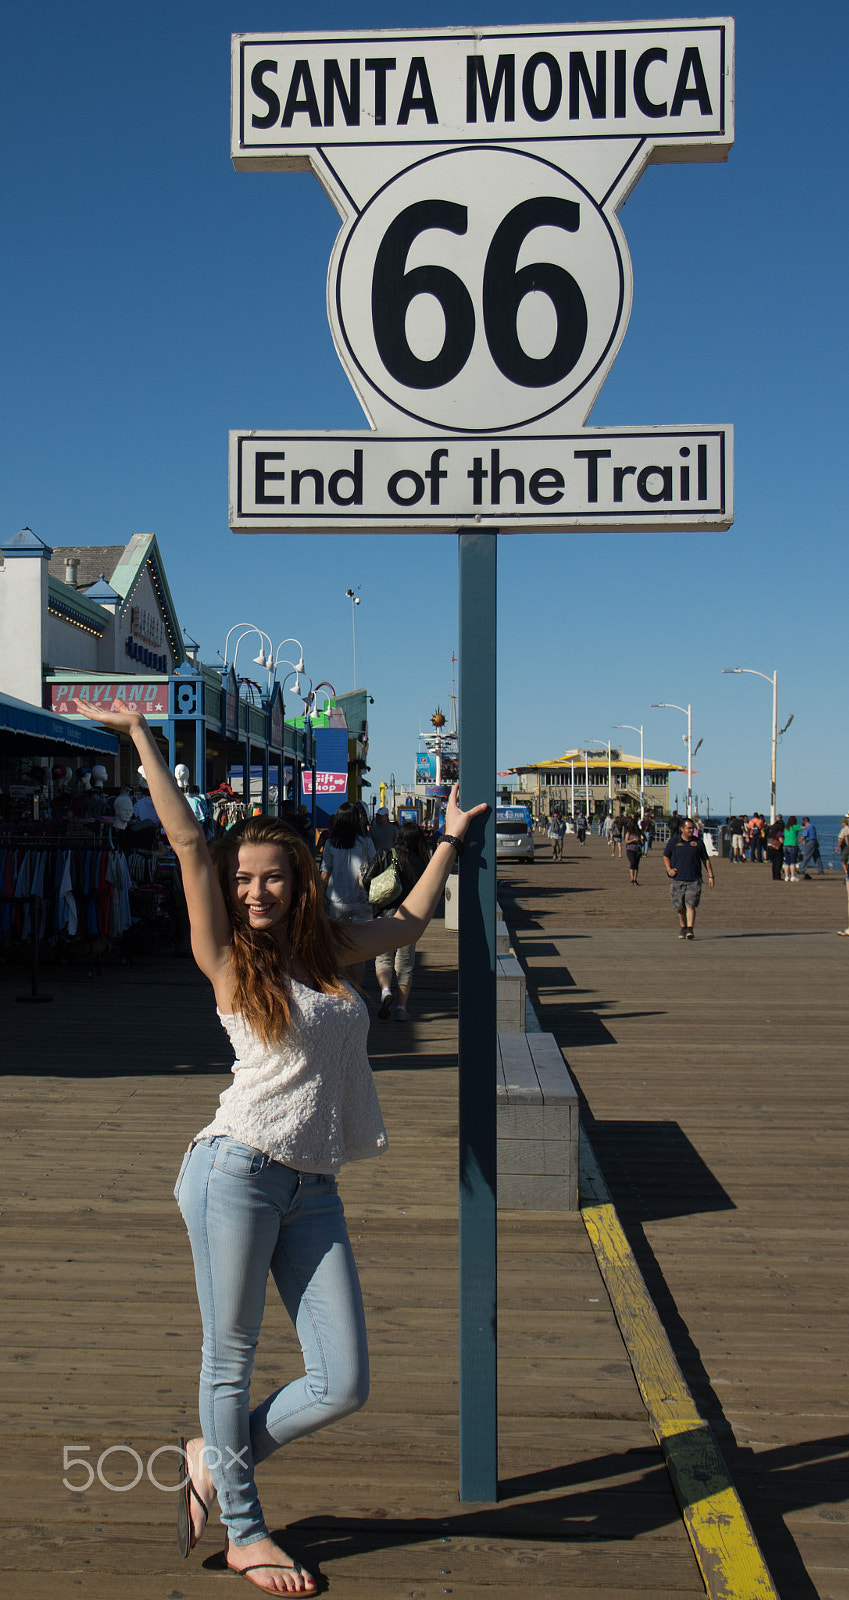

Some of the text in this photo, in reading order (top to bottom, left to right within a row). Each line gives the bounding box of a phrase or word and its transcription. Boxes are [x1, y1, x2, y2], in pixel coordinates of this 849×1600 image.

[250, 46, 713, 130] SANTA MONICA
[371, 196, 588, 390] 66
[254, 444, 708, 507] End of the Trail
[55, 685, 158, 702] PLAYLAND
[59, 702, 153, 712] AADE
[307, 782, 336, 792] Shop
